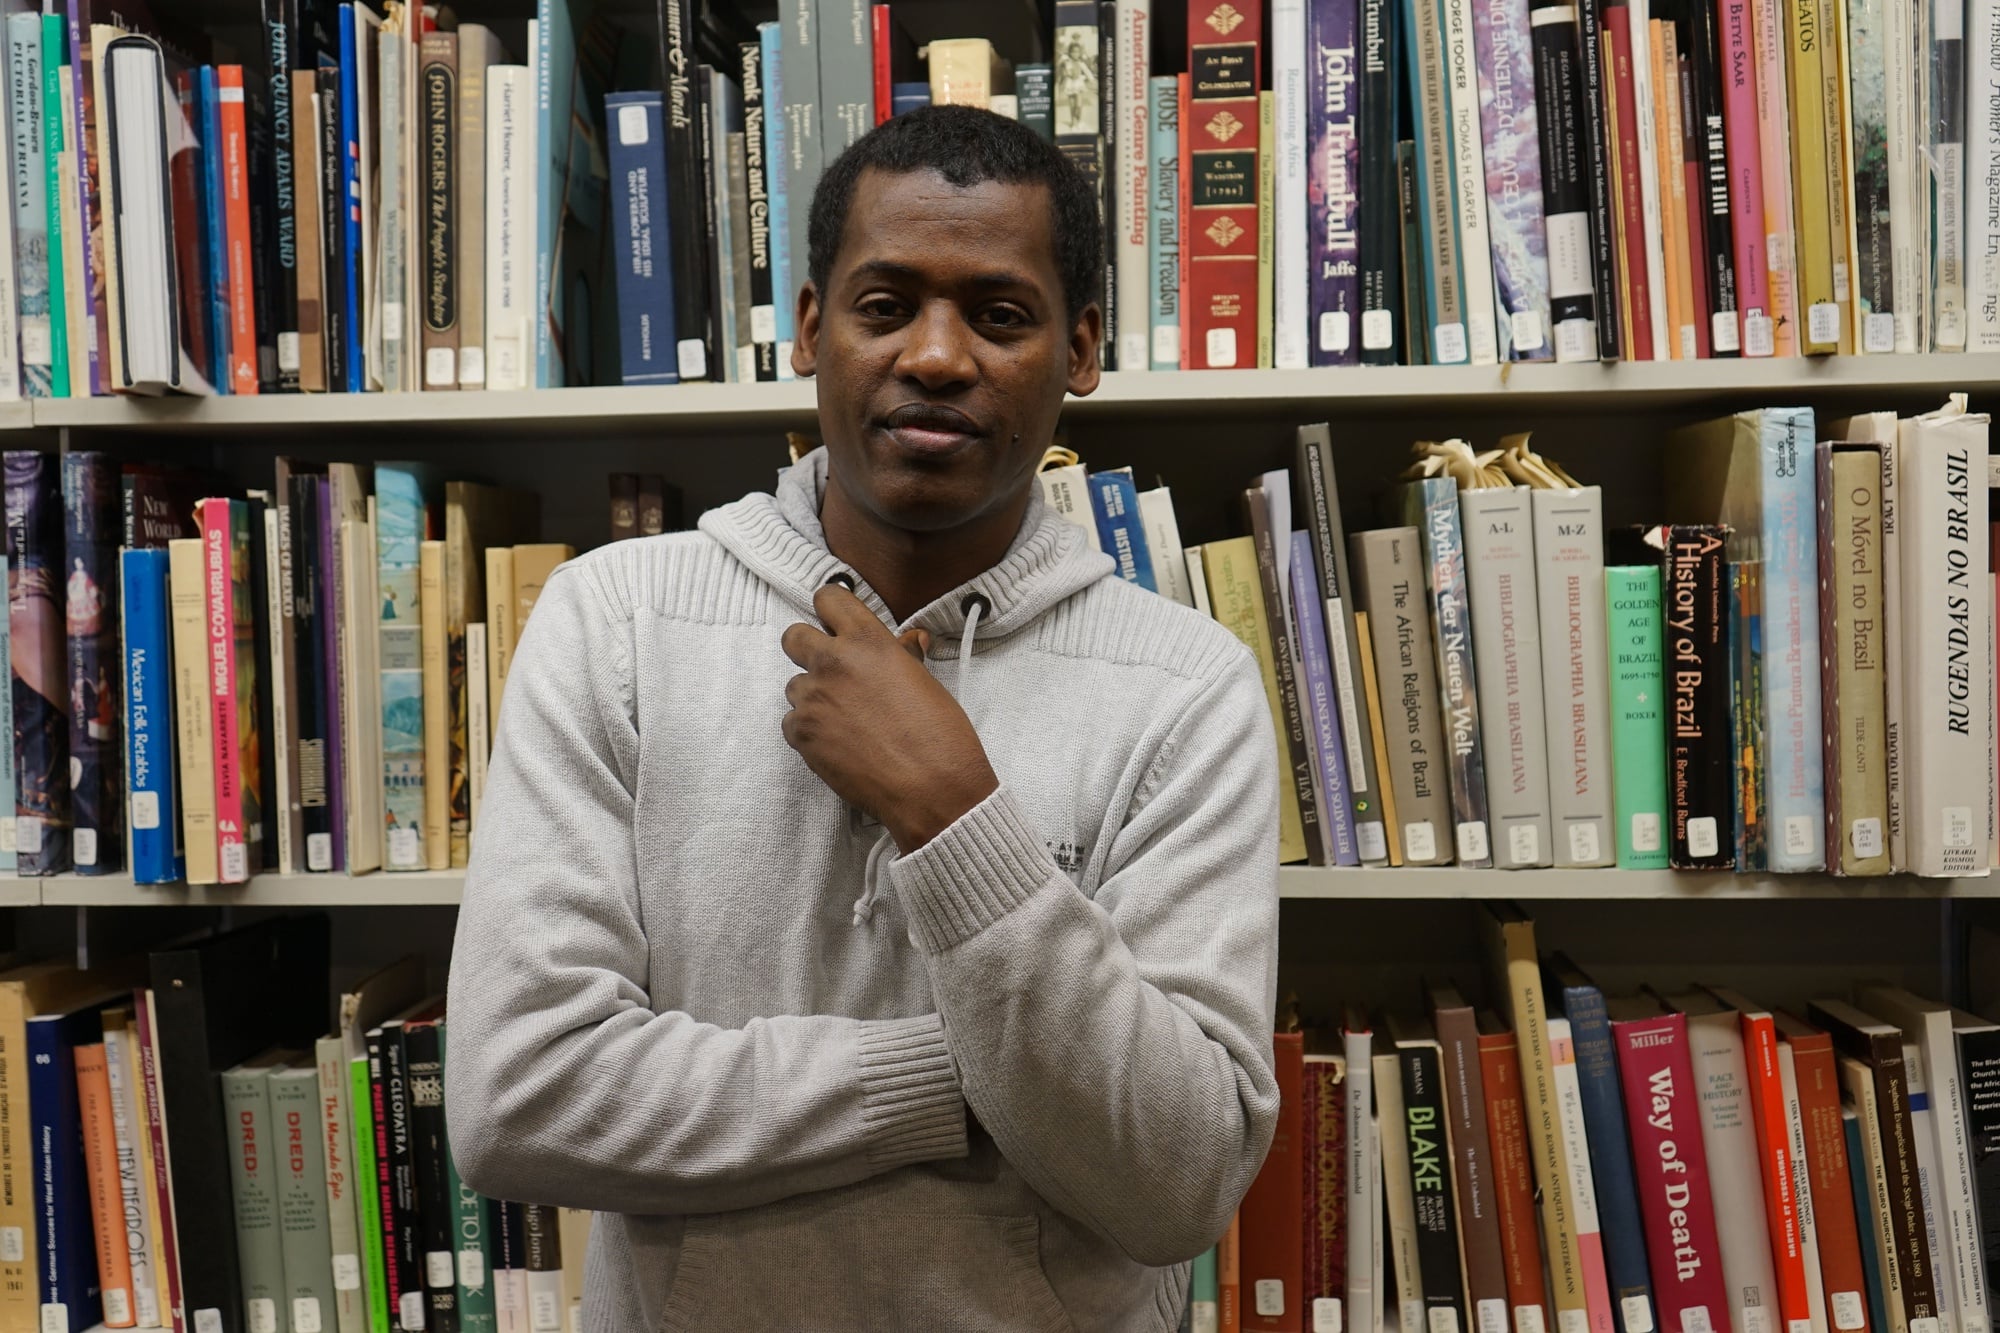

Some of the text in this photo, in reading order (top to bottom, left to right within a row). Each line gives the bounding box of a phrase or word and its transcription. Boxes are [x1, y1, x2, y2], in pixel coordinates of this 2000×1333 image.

[1453, 38, 1467, 89] TOOKER
[1560, 51, 1571, 85] DEGAS
[1729, 4, 1747, 88] BETYE SAAR
[27, 57, 41, 154] Gordon-Brown
[540, 53, 549, 110] PURYEAR
[670, 74, 690, 128] Morals
[1825, 76, 1837, 99] Early
[14, 41, 28, 209] PICTORIAL AFRICANA
[268, 20, 294, 268] JOHN QUINCY ADAMS WARD
[1131, 9, 1147, 246] American Genre Painting
[1285, 68, 1299, 178] Reinventing Africa
[1563, 104, 1574, 130] NEW
[742, 46, 769, 268] Novak Nature and Culture
[1321, 46, 1357, 252] John Trumbull
[1457, 108, 1478, 229] THOMAS H. GARVER
[1565, 133, 1577, 182] ORLEANS
[428, 74, 447, 324] JOHN ROGERS The People's Sculptor
[638, 167, 652, 277] HIS IDEAL SCULPTURE
[1157, 86, 1180, 316] ROSE Slavery and Freedom
[632, 240, 642, 274] HIRAM
[1323, 261, 1356, 278] Jaffe
[640, 314, 651, 360] REYNOLDS
[143, 496, 167, 517] NEW
[1060, 482, 1075, 512] ALFREDO
[1102, 484, 1115, 518] BOULTON
[1110, 483, 1124, 515] ALFREDO
[279, 505, 292, 552] IMAGES
[1113, 528, 1134, 581] HISTORIA
[1488, 524, 1514, 535] A-L
[1557, 524, 1587, 538] M-Z
[1701, 533, 1722, 554] A
[281, 569, 294, 617] MEXICO
[1614, 600, 1660, 610] GOLDEN
[1626, 582, 1648, 592] THE
[1851, 487, 1875, 671] O Móvel no Brasil
[1946, 448, 1970, 737] RUGENDAS NO BRASIL
[208, 530, 230, 696] MIGUEL COVARRUBIAS
[1430, 508, 1475, 756] Mythen der Neuen Welt
[1628, 618, 1650, 628] AGE
[1632, 636, 1647, 645] OF
[1669, 543, 1701, 738] History of Brazil
[495, 604, 506, 679] Guaman Poma
[1393, 581, 1430, 798] The African Religions of Brazil
[1498, 574, 1526, 794] BIBLIOGRAPHIA BRASILIANA
[1567, 575, 1588, 796] BIBLIOGRAPHIA BRASILIANA
[131, 649, 148, 787] Mexican Folk Retablos
[1286, 685, 1304, 742] GUARAIRA
[1625, 712, 1657, 720] BOXER
[217, 702, 231, 797] SYLVIA NAVARRETE
[1315, 682, 1350, 855] RETRATOS QUASE INOCENTES
[1855, 717, 1867, 773] TILDE CANTI
[1304, 808, 1318, 824] EL
[1677, 747, 1689, 840] E. Bradford Burns
[1944, 848, 1978, 856] LIVRARIA
[1944, 856, 1975, 864] KOSMOS
[1630, 1035, 1674, 1049] Miller
[389, 1044, 408, 1154] Signs of CLEOPATRA
[1353, 1089, 1362, 1101] Dr.
[116, 1148, 138, 1182] NEW
[240, 1111, 258, 1179] DRED:
[287, 1112, 304, 1180] DRED:
[324, 1096, 343, 1200] The Mwindo Epic
[1317, 1071, 1337, 1239] SAMUEL JOHNSON
[1353, 1150, 1362, 1195] Household
[1408, 1107, 1442, 1192] BLAKE
[1647, 1066, 1702, 1282] Way of Death
[1418, 1196, 1428, 1225] EMPIRE
[1426, 1196, 1437, 1232] AGAINST
[1435, 1196, 1446, 1232] PROPHET
[1875, 1165, 1899, 1292] THE NEGRO CHURCH IN AMERICA
[526, 1233, 543, 1269] Jones
